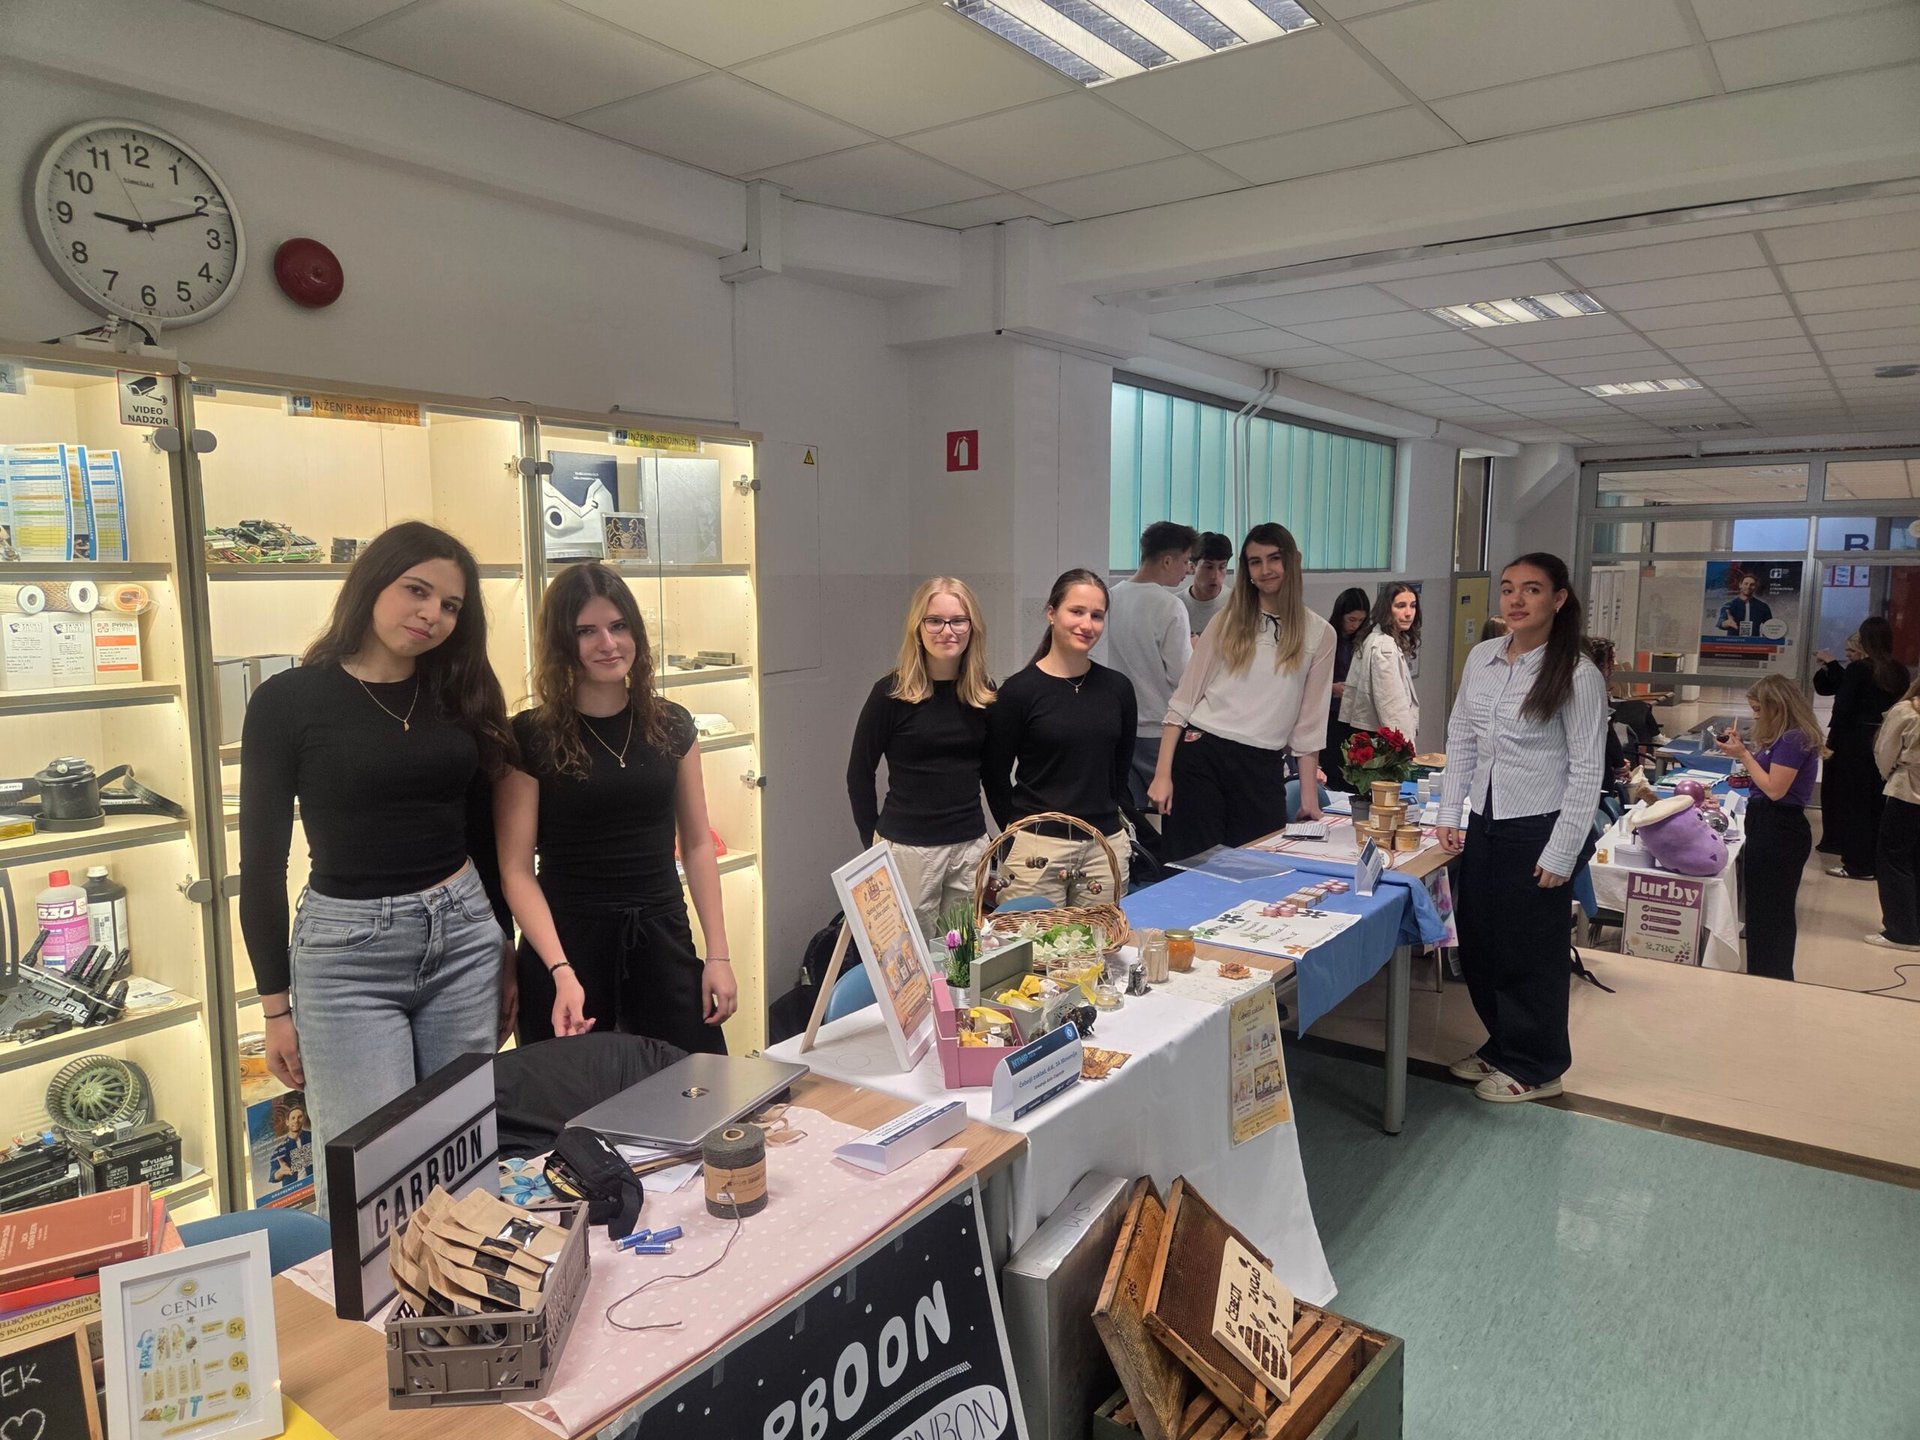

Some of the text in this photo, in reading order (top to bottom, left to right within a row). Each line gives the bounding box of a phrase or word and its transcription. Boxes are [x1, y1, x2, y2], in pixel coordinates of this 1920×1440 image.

[87, 147, 110, 171] 11
[121, 143, 150, 169] 12
[64, 169, 94, 194] 10
[169, 164, 179, 185] 1
[56, 201, 73, 224] 9
[193, 195, 209, 217] 2
[206, 229, 221, 250] 3
[72, 241, 89, 263] 8
[102, 270, 119, 291] 7
[198, 263, 213, 283] 4
[141, 285, 157, 307] 6
[176, 281, 191, 302] 5
[128, 414, 169, 425] NADZOR
[132, 405, 163, 415] VIDEO
[355, 406, 419, 418] MEHATRONIKE
[628, 432, 655, 442] INŽENIR
[1633, 876, 1699, 906] Jurby
[150, 1154, 173, 1165] YUASA
[52, 1304, 93, 1322] TRIJEZIČNI
[161, 1292, 218, 1317] CENIK
[7, 1319, 50, 1336] POSLOVNI
[229, 1322, 243, 1334] 5€
[1225, 1321, 1236, 1338] UP
[232, 1356, 245, 1368] 3€
[235, 1386, 247, 1397] 2€
